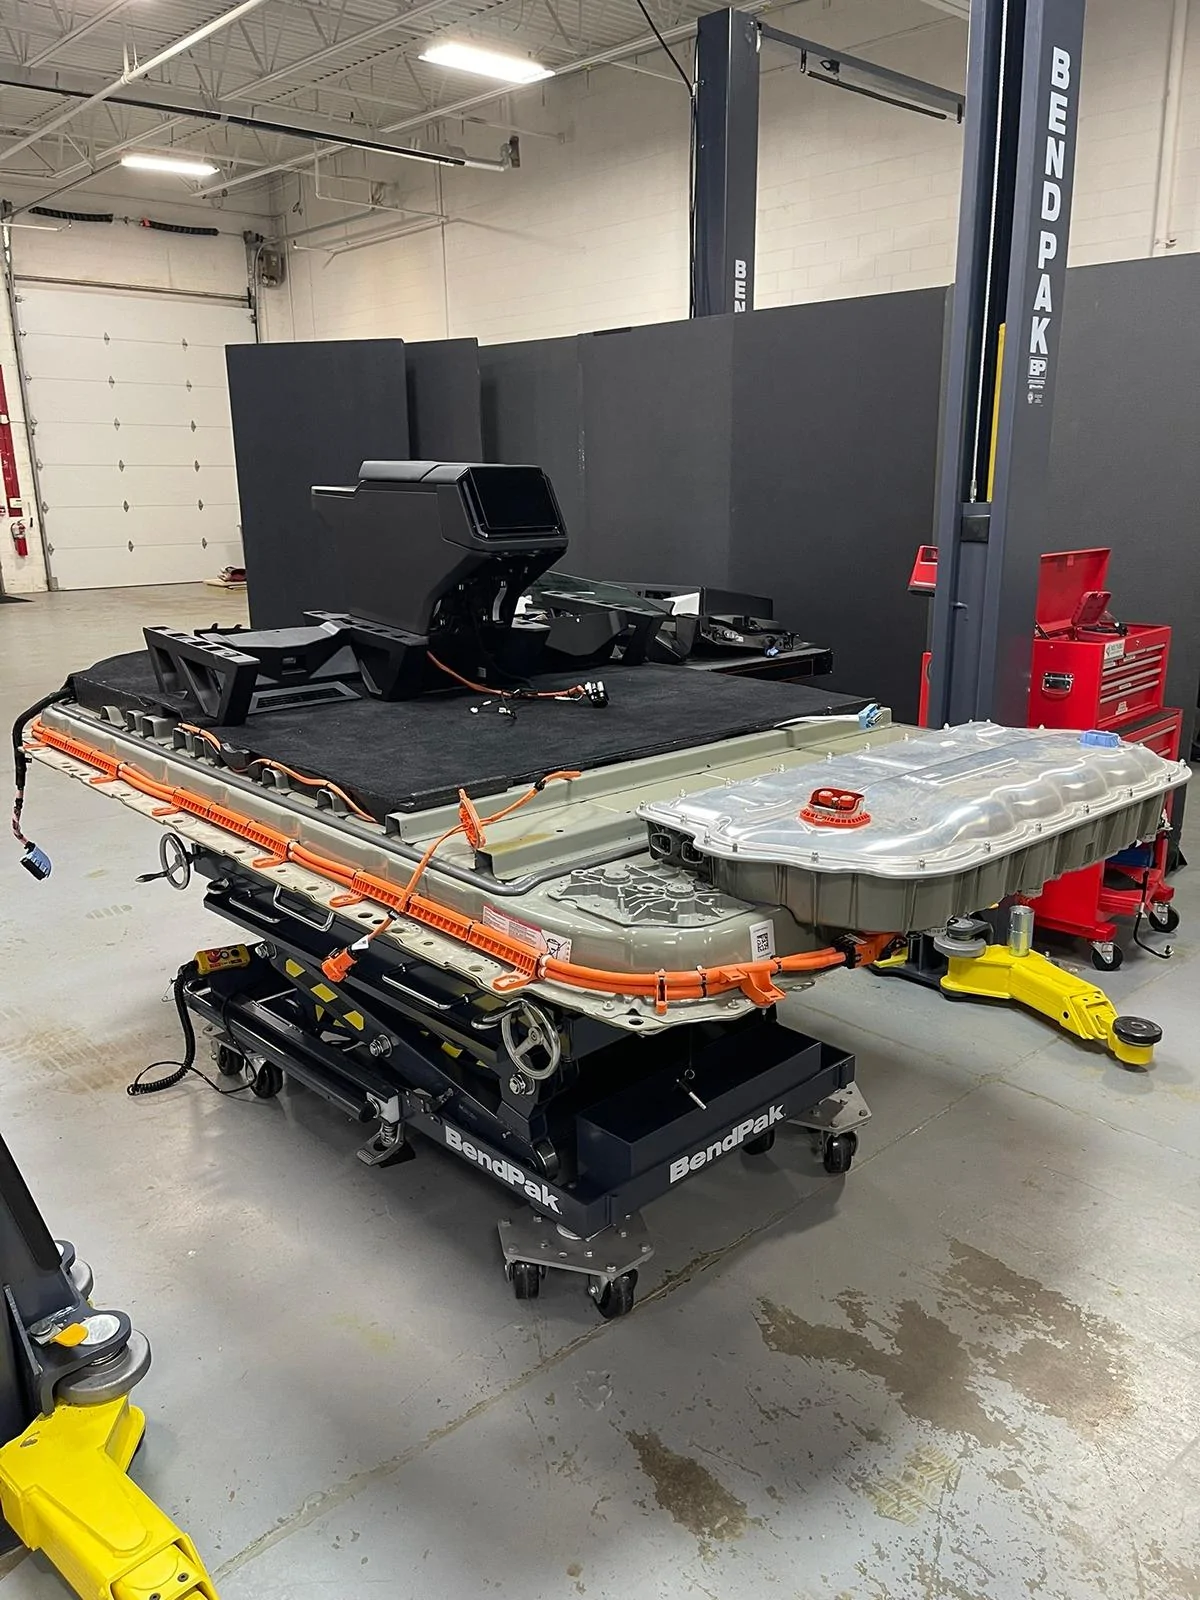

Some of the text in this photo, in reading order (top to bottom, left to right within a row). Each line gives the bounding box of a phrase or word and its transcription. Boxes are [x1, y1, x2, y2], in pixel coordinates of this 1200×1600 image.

[1029, 46, 1071, 354] BENDPAK
[445, 1125, 561, 1215] BendPak
[669, 1104, 785, 1184] BendPak
